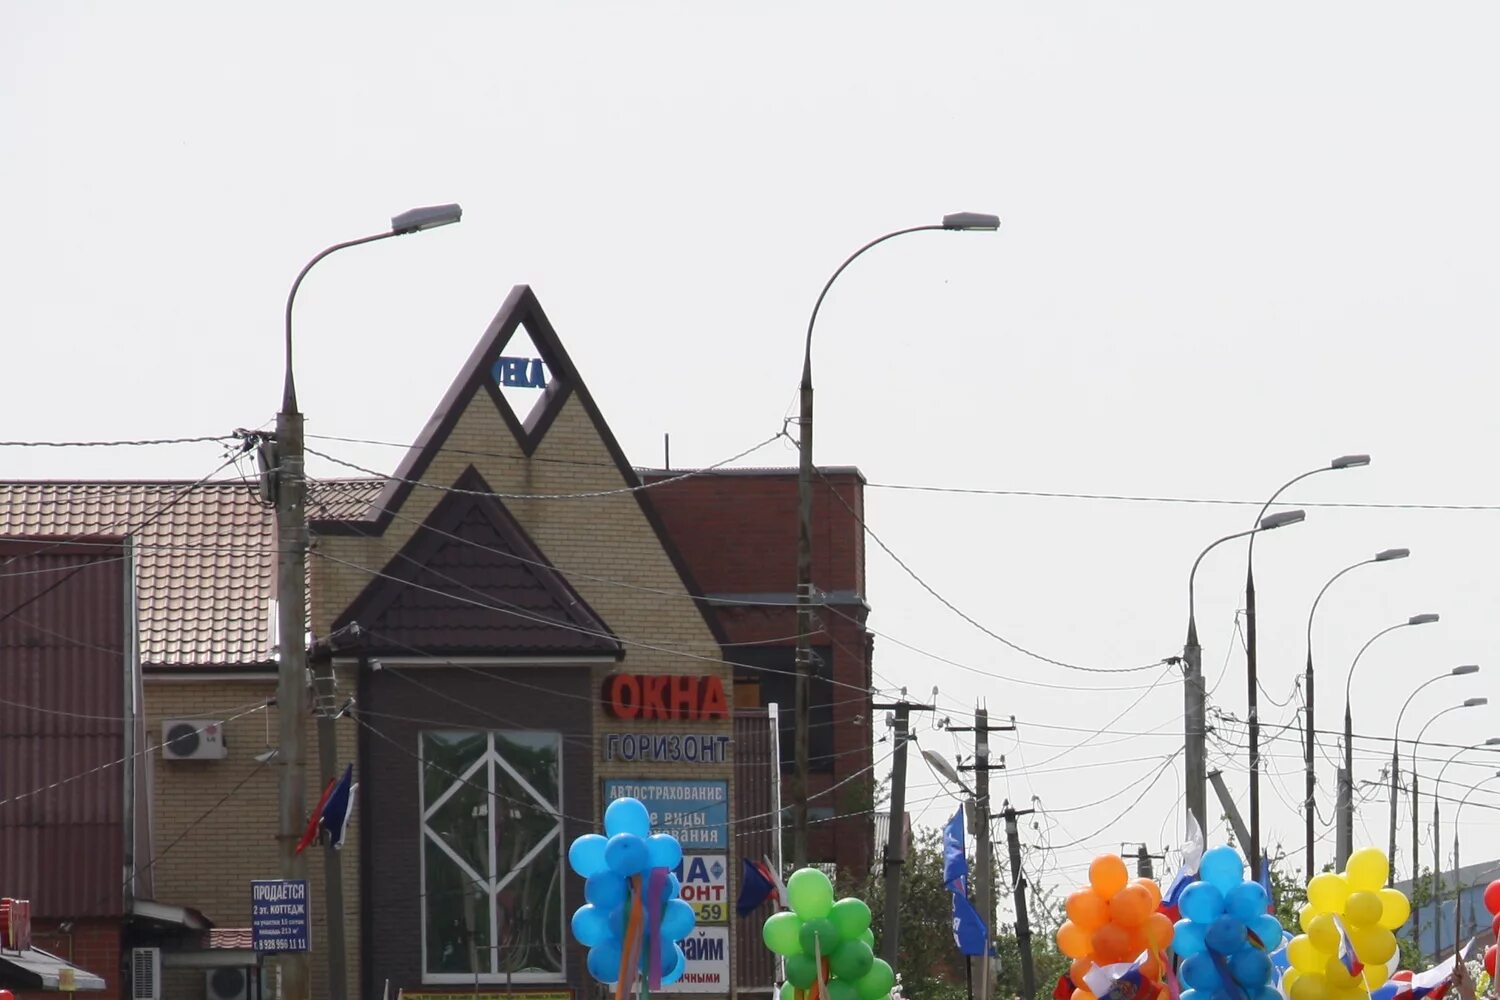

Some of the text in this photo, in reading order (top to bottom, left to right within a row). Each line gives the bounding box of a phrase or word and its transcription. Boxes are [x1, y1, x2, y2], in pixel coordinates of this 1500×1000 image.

[611, 673, 729, 720] ОКНА
[607, 733, 730, 761] ГОРИЗОНТ
[610, 785, 723, 801] АВТОСТРАХОВАНИЕ
[664, 812, 706, 828] виды
[253, 882, 305, 902] ПРОДАЁТСЯ
[678, 885, 725, 901] ОНТ
[253, 905, 258, 915] 2
[270, 904, 304, 915] КОТТЕДЖ
[694, 904, 722, 920] -59
[675, 973, 721, 984] ичными
